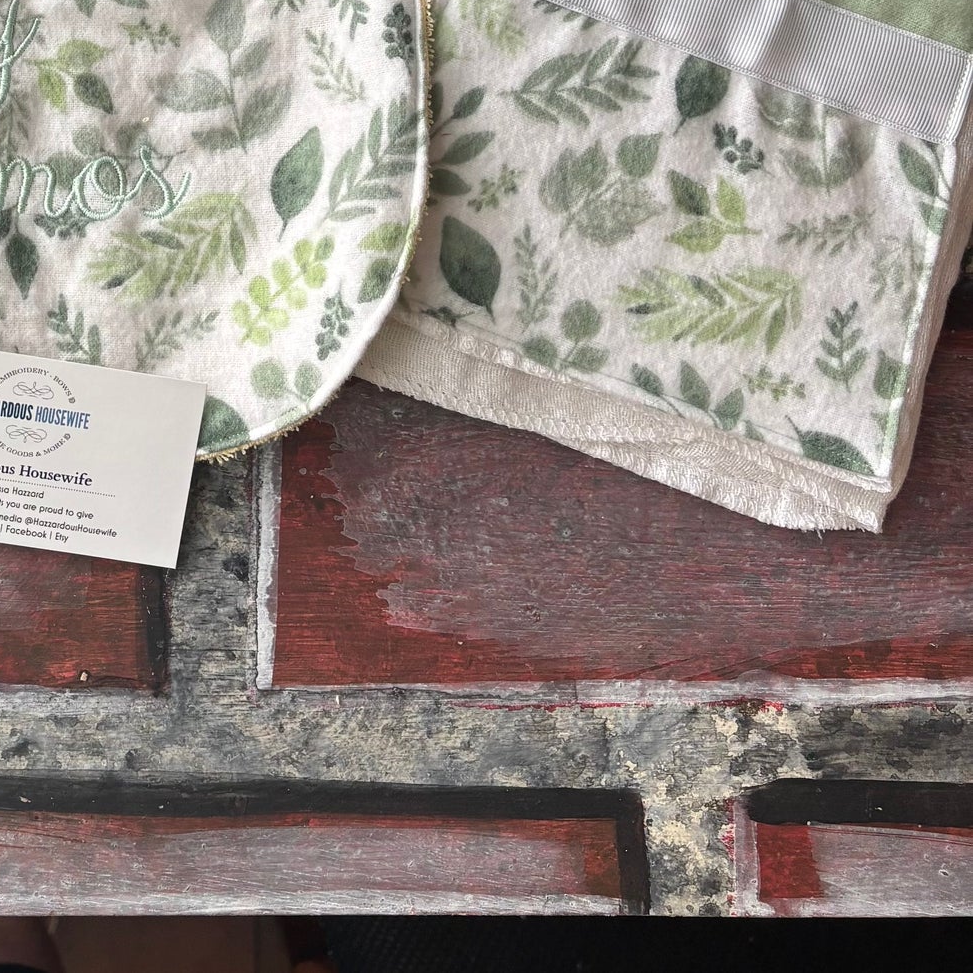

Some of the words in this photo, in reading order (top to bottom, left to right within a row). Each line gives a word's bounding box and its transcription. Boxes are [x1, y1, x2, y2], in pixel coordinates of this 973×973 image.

[53, 375, 73, 397] BOWS
[34, 406, 91, 429] HOUSEWIFE
[6, 447, 34, 458] GOODS
[43, 438, 66, 456] MORE
[19, 464, 93, 487] Housewife
[12, 487, 45, 499] Hazzard
[6, 500, 21, 509] you
[22, 503, 37, 511] are
[39, 505, 64, 515] proud
[65, 508, 74, 517] to
[76, 511, 94, 520] give
[5, 524, 47, 539] Facebook
[55, 532, 69, 544] Etsy
[24, 516, 118, 538] @HazzardousHousewife
